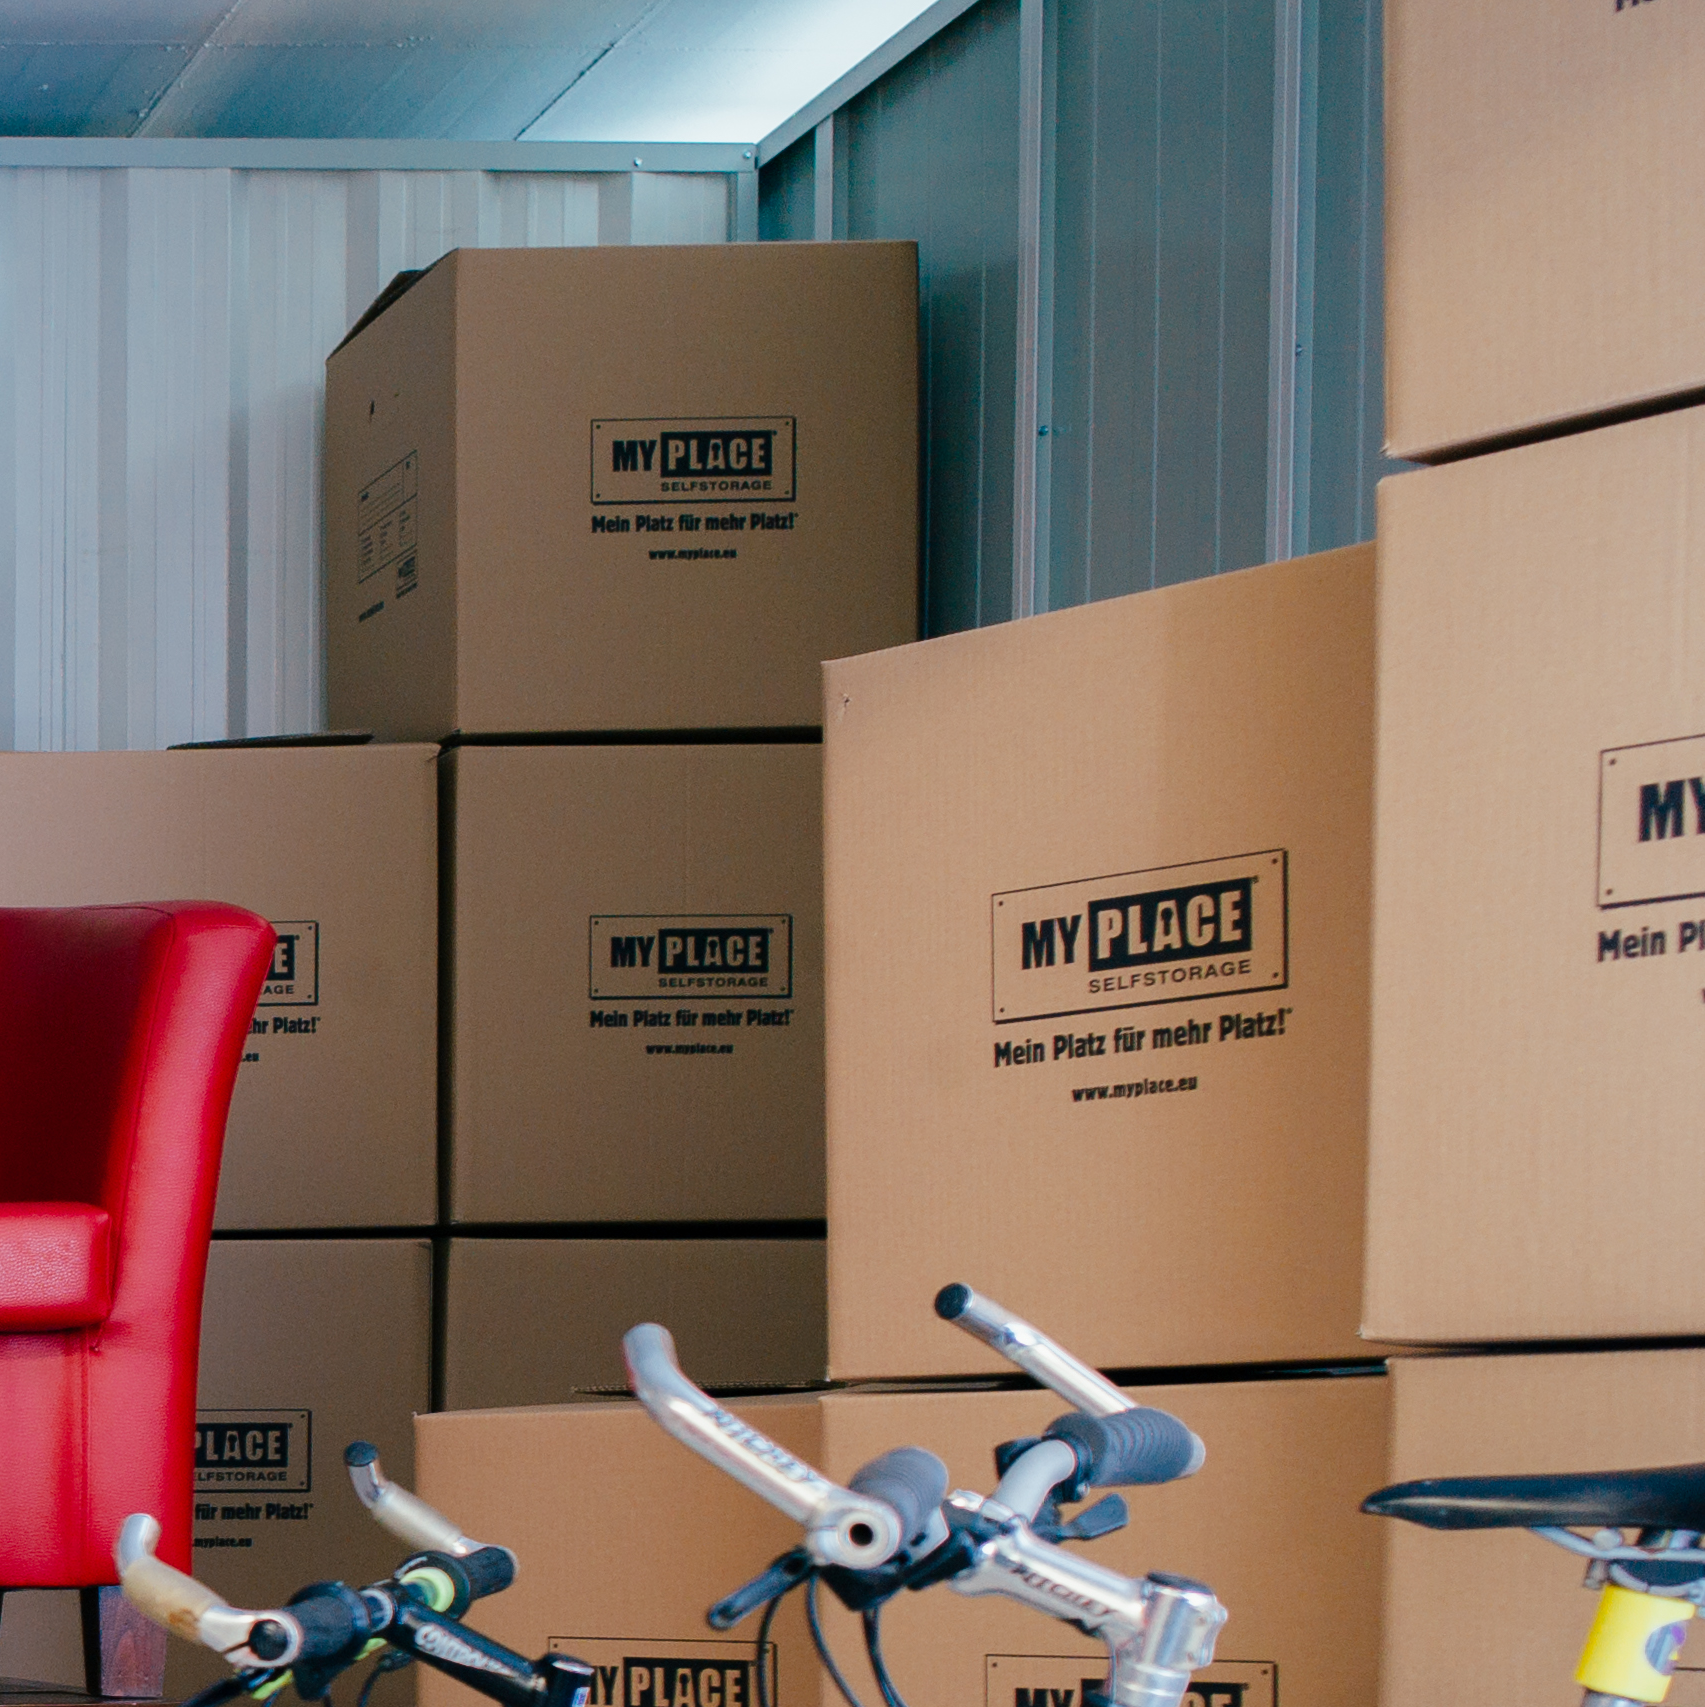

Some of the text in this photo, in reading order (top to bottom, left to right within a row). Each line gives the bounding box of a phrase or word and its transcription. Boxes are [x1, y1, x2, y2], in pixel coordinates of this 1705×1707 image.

[612, 437, 766, 472] MY PLACE
[661, 480, 772, 492] SELFSTORAGE
[591, 512, 795, 533] Mein Platz für mehr Platz!
[1022, 890, 1242, 970] MY PLACE
[610, 935, 762, 968] MY PLACE
[1598, 926, 1666, 962] Mein
[658, 977, 768, 988] SELFSTORAGE
[1089, 959, 1252, 994] SELFSTORAGE
[272, 1017, 317, 1034] Platz!
[590, 1008, 791, 1028] Mein Platz für mehr Platz!
[994, 1007, 1285, 1068] Mein Platz für mehr Platz!
[1072, 1076, 1198, 1102] www.myplace.eu
[193, 1471, 287, 1482] LFSTORAGE
[195, 1503, 308, 1520] für mehr Platz!
[193, 1537, 253, 1549] .myplace.eu
